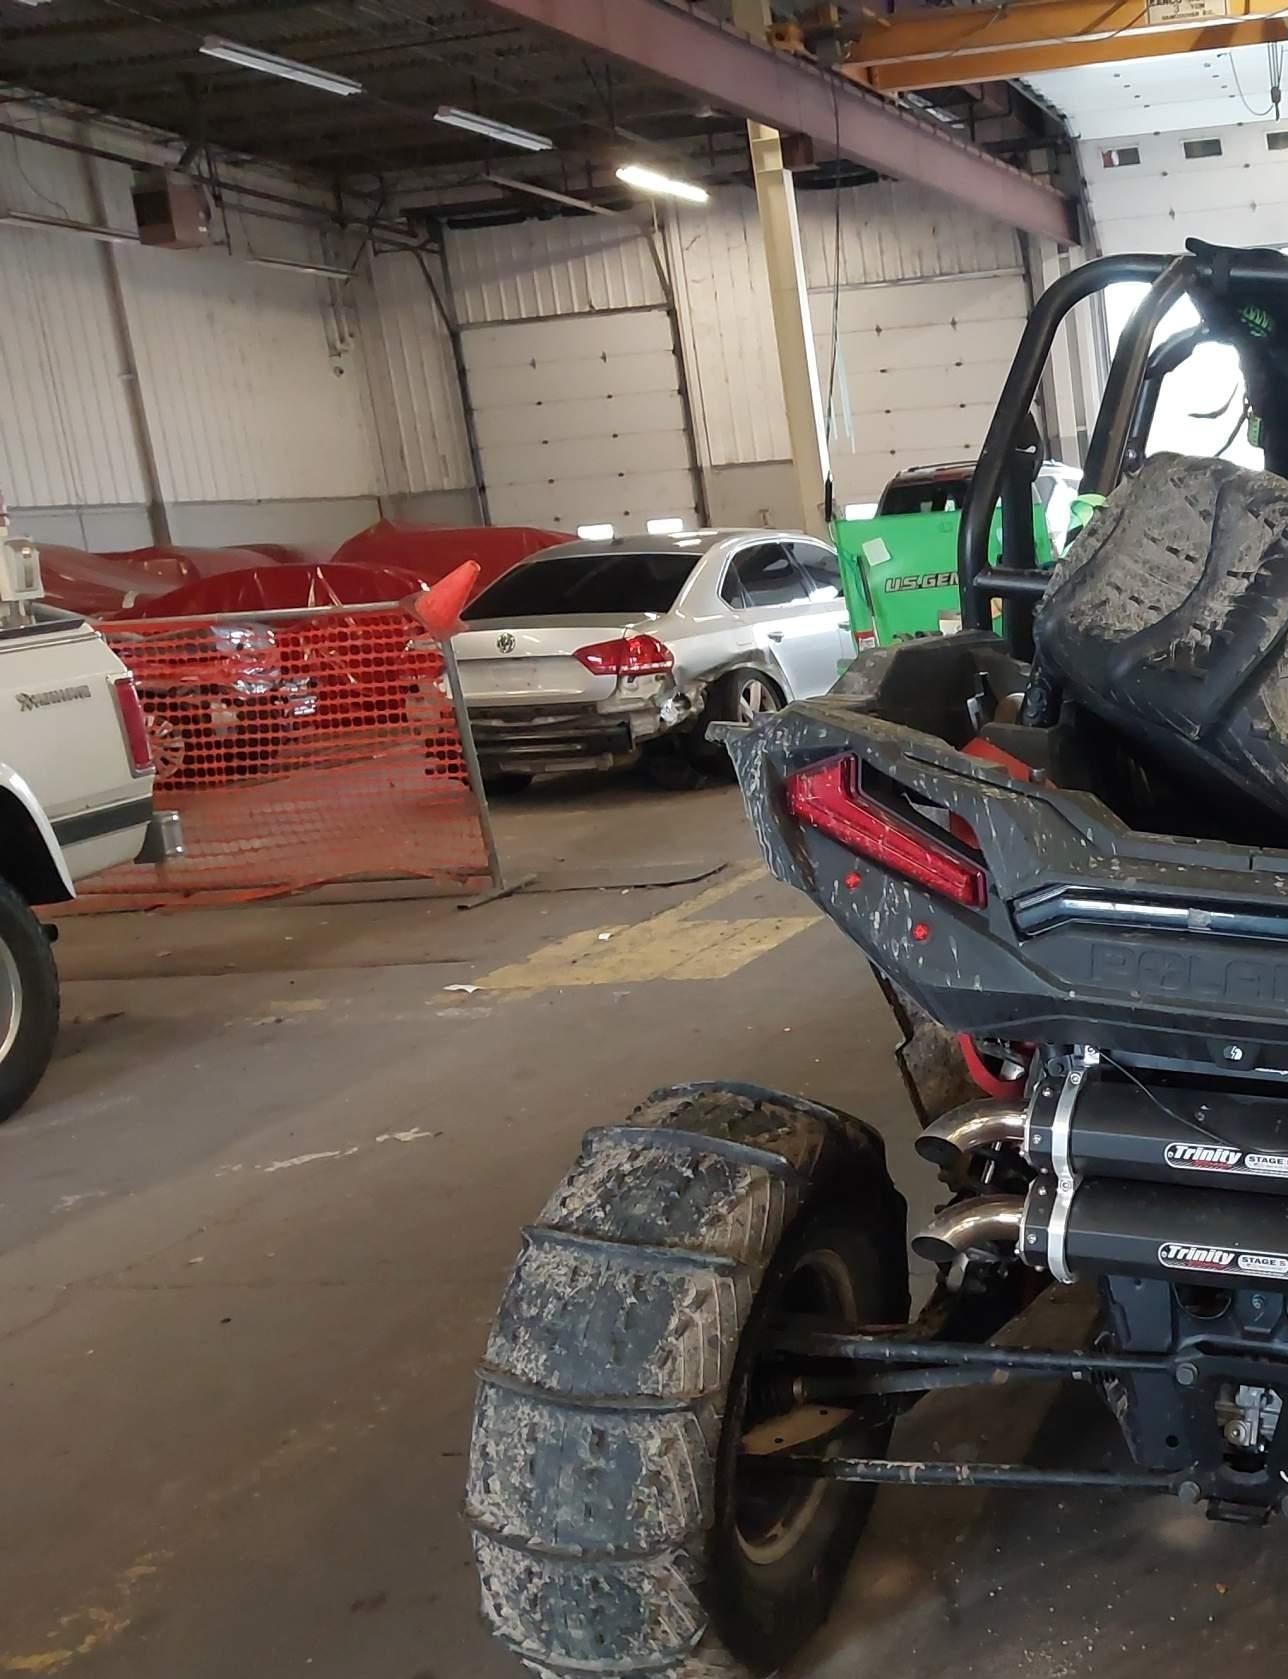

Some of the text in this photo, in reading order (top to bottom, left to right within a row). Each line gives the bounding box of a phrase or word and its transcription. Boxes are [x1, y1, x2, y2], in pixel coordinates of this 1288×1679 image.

[1174, 1145, 1243, 1165] Trinity
[1249, 1156, 1284, 1165] STAGE
[1167, 1245, 1235, 1265] Trinity
[1241, 1256, 1277, 1266] STAGE
